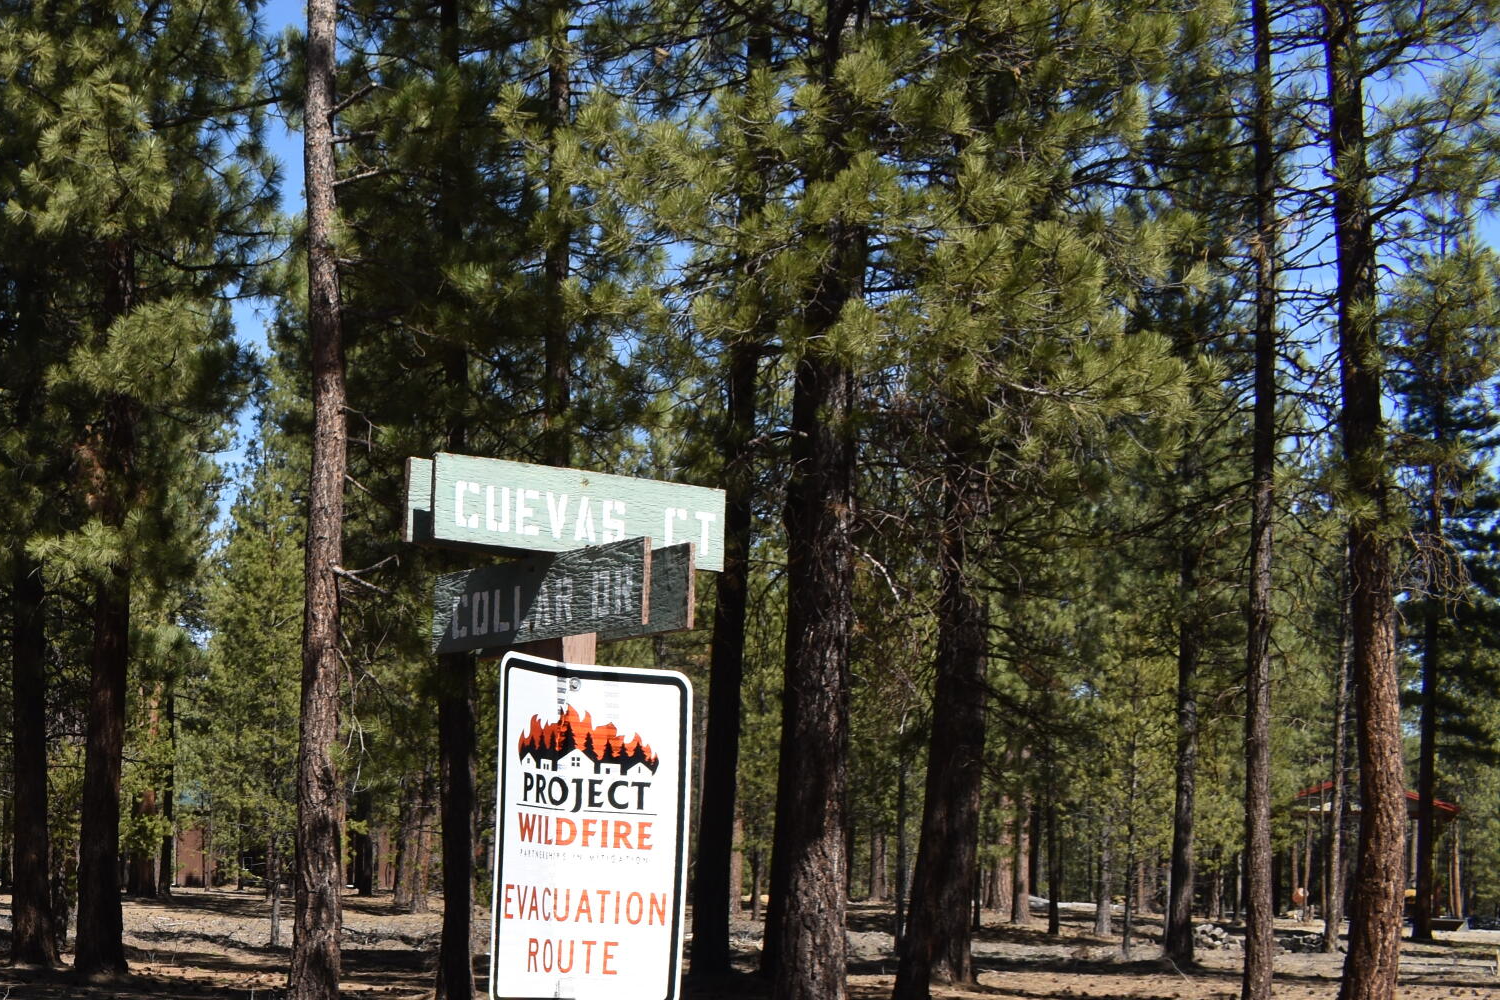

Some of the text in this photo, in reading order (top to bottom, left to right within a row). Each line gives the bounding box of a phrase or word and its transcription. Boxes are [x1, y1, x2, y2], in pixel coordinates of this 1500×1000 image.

[455, 480, 717, 556] CUEVAS CT
[451, 564, 634, 640] COLLAR DR
[522, 771, 652, 813] PROJECT
[518, 812, 654, 850] WILDFIRE
[503, 883, 667, 926] EVACUATION
[527, 938, 620, 976] ROUTE
